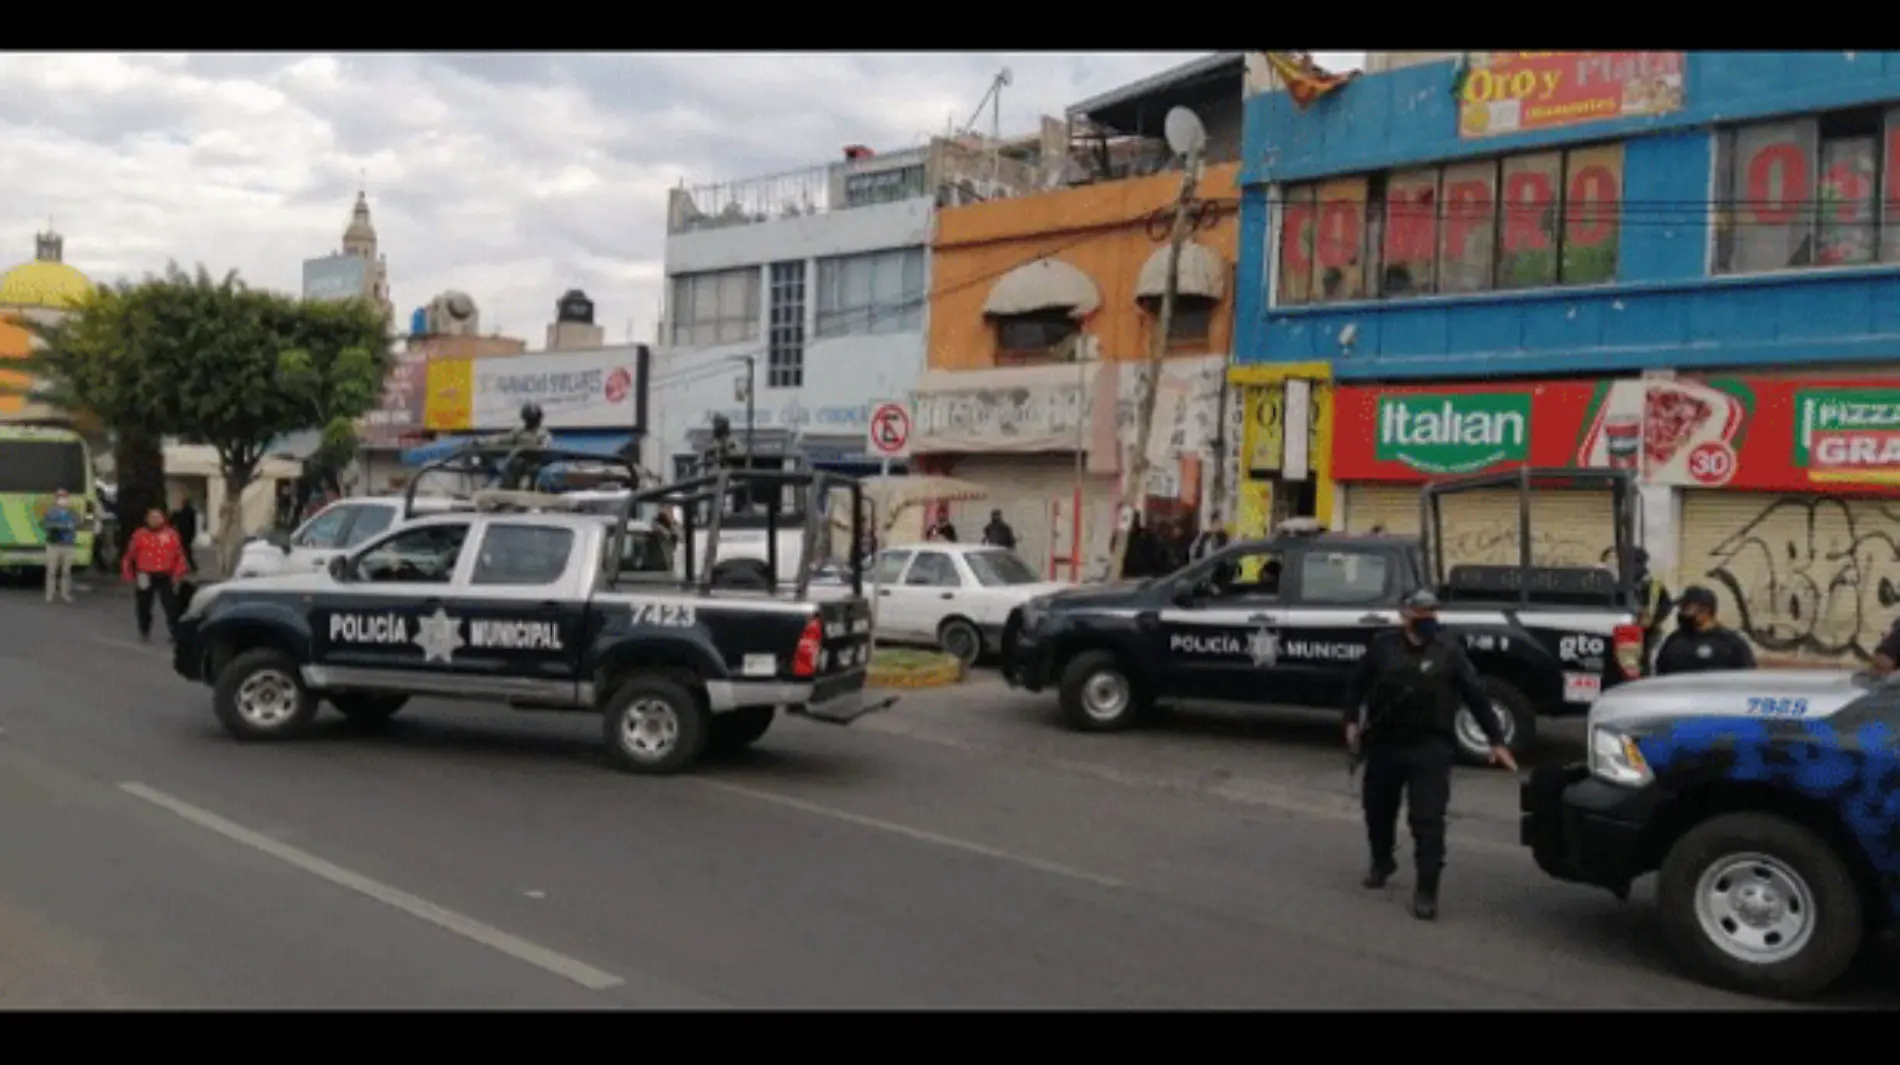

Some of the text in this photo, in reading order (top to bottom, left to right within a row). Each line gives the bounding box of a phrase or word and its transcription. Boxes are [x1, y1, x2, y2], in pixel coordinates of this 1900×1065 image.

[1464, 68, 1536, 104] Oro
[1283, 163, 1617, 274] COMPRO
[1381, 399, 1525, 446] Italian
[1690, 450, 1730, 477] 30
[329, 611, 564, 650] POLICÍA MUNICIPAL
[630, 602, 698, 628] 7423
[1169, 632, 1240, 653] POLICÍA
[1559, 635, 1605, 661] gto
